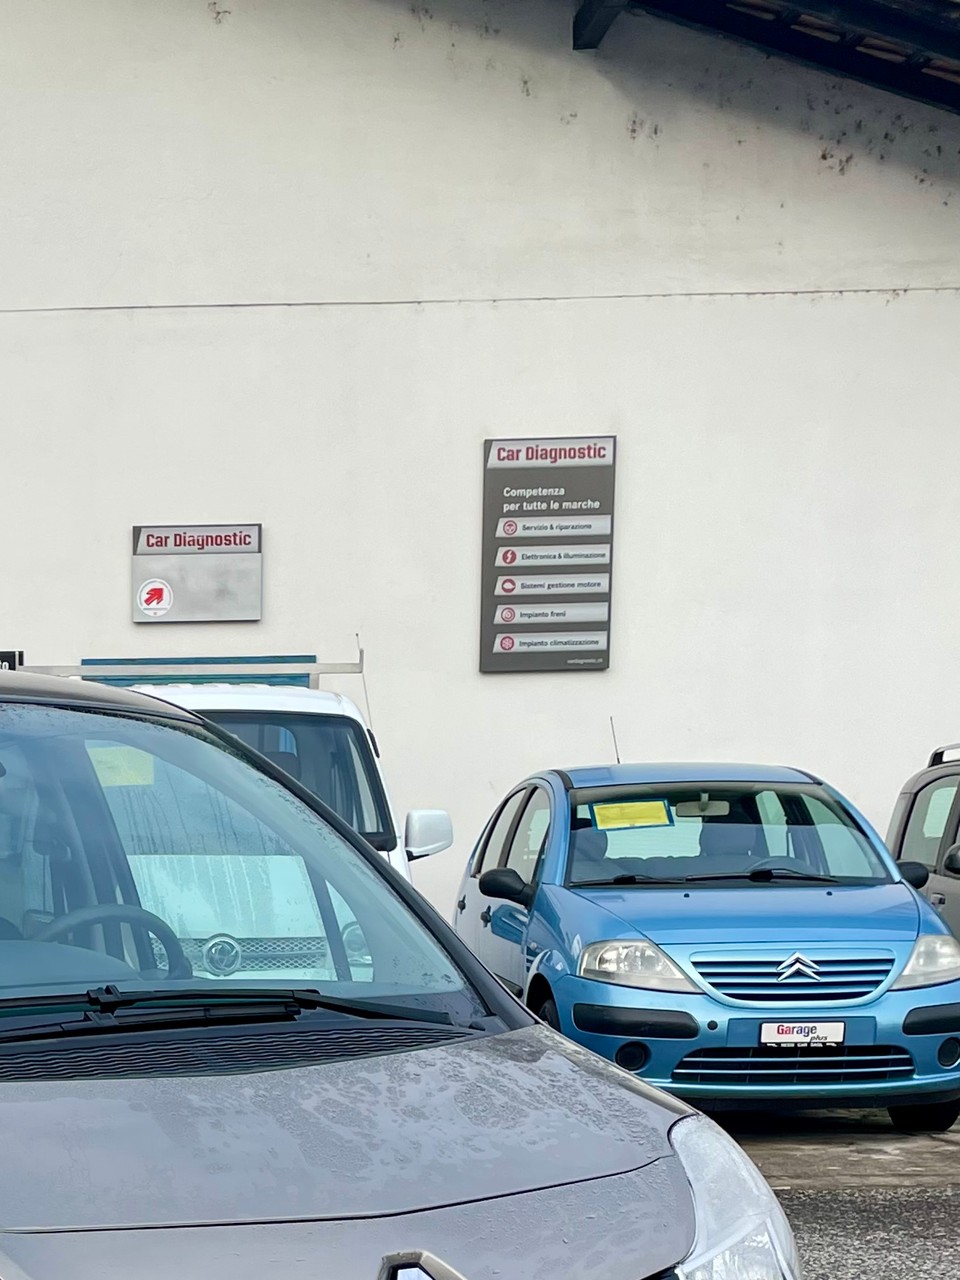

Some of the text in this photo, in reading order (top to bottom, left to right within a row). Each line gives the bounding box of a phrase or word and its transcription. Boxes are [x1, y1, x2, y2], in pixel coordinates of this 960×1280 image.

[497, 443, 607, 464] Car Diagnostic
[503, 487, 566, 499] Competenza
[503, 499, 601, 513] per tutte le marche
[146, 531, 252, 551] Car Diagnostic
[521, 553, 557, 561] Elettronica
[546, 582, 575, 590] gestione
[519, 610, 567, 619] Impianto freni
[518, 639, 600, 648] Impianto climatizzazione
[777, 1024, 817, 1037] Garage
[809, 1034, 828, 1043] plus
